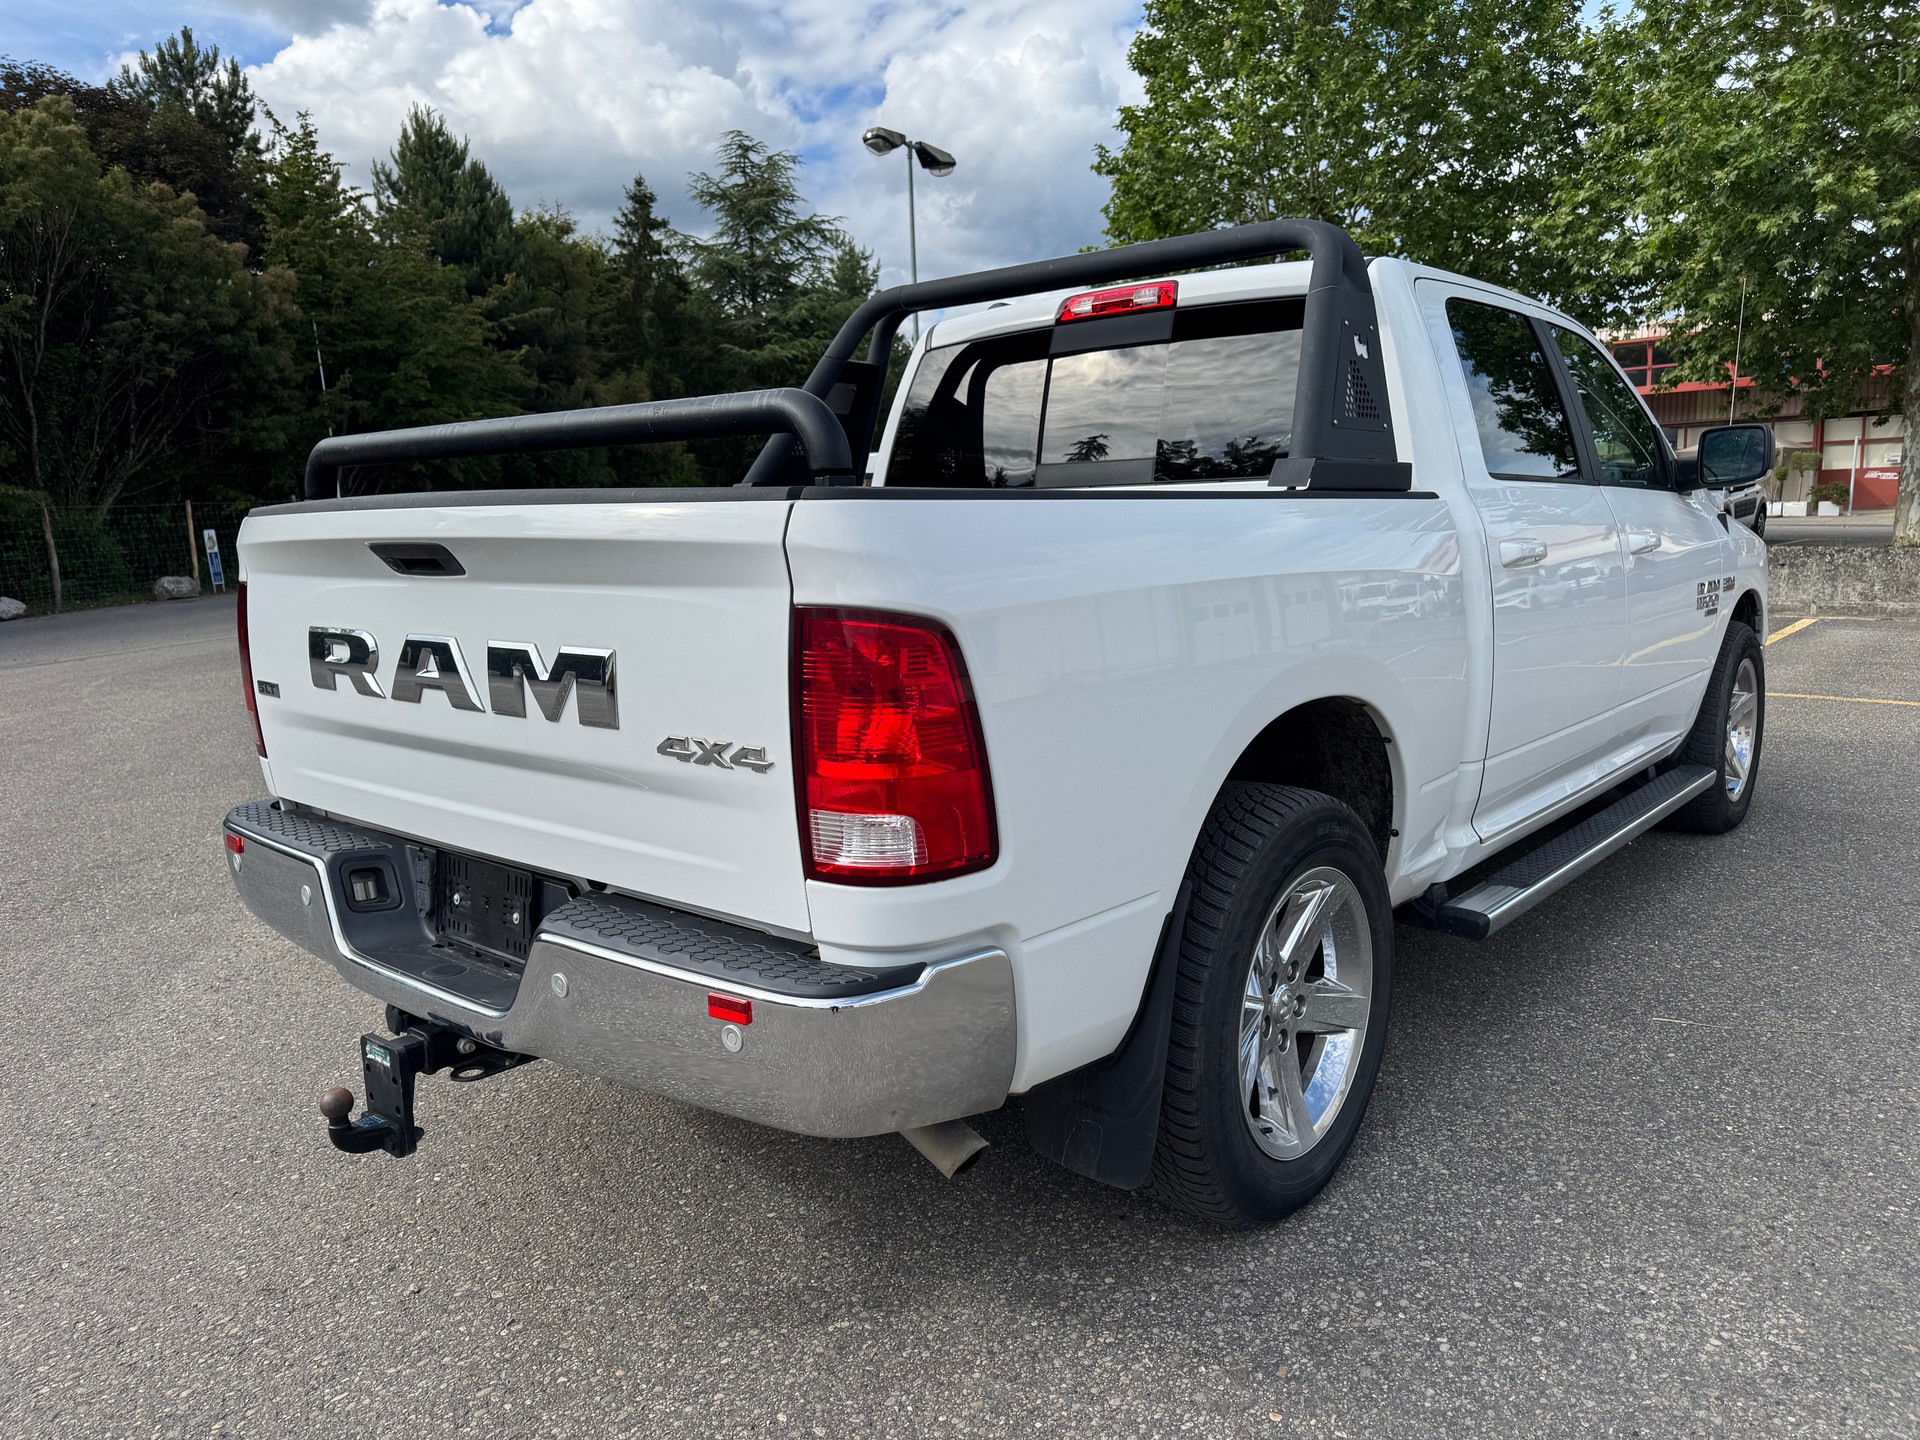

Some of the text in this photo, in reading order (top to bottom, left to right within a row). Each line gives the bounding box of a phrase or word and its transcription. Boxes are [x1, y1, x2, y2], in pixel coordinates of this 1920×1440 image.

[258, 683, 277, 696] SLT
[308, 626, 620, 730] RAM
[657, 734, 775, 774] 4X4
